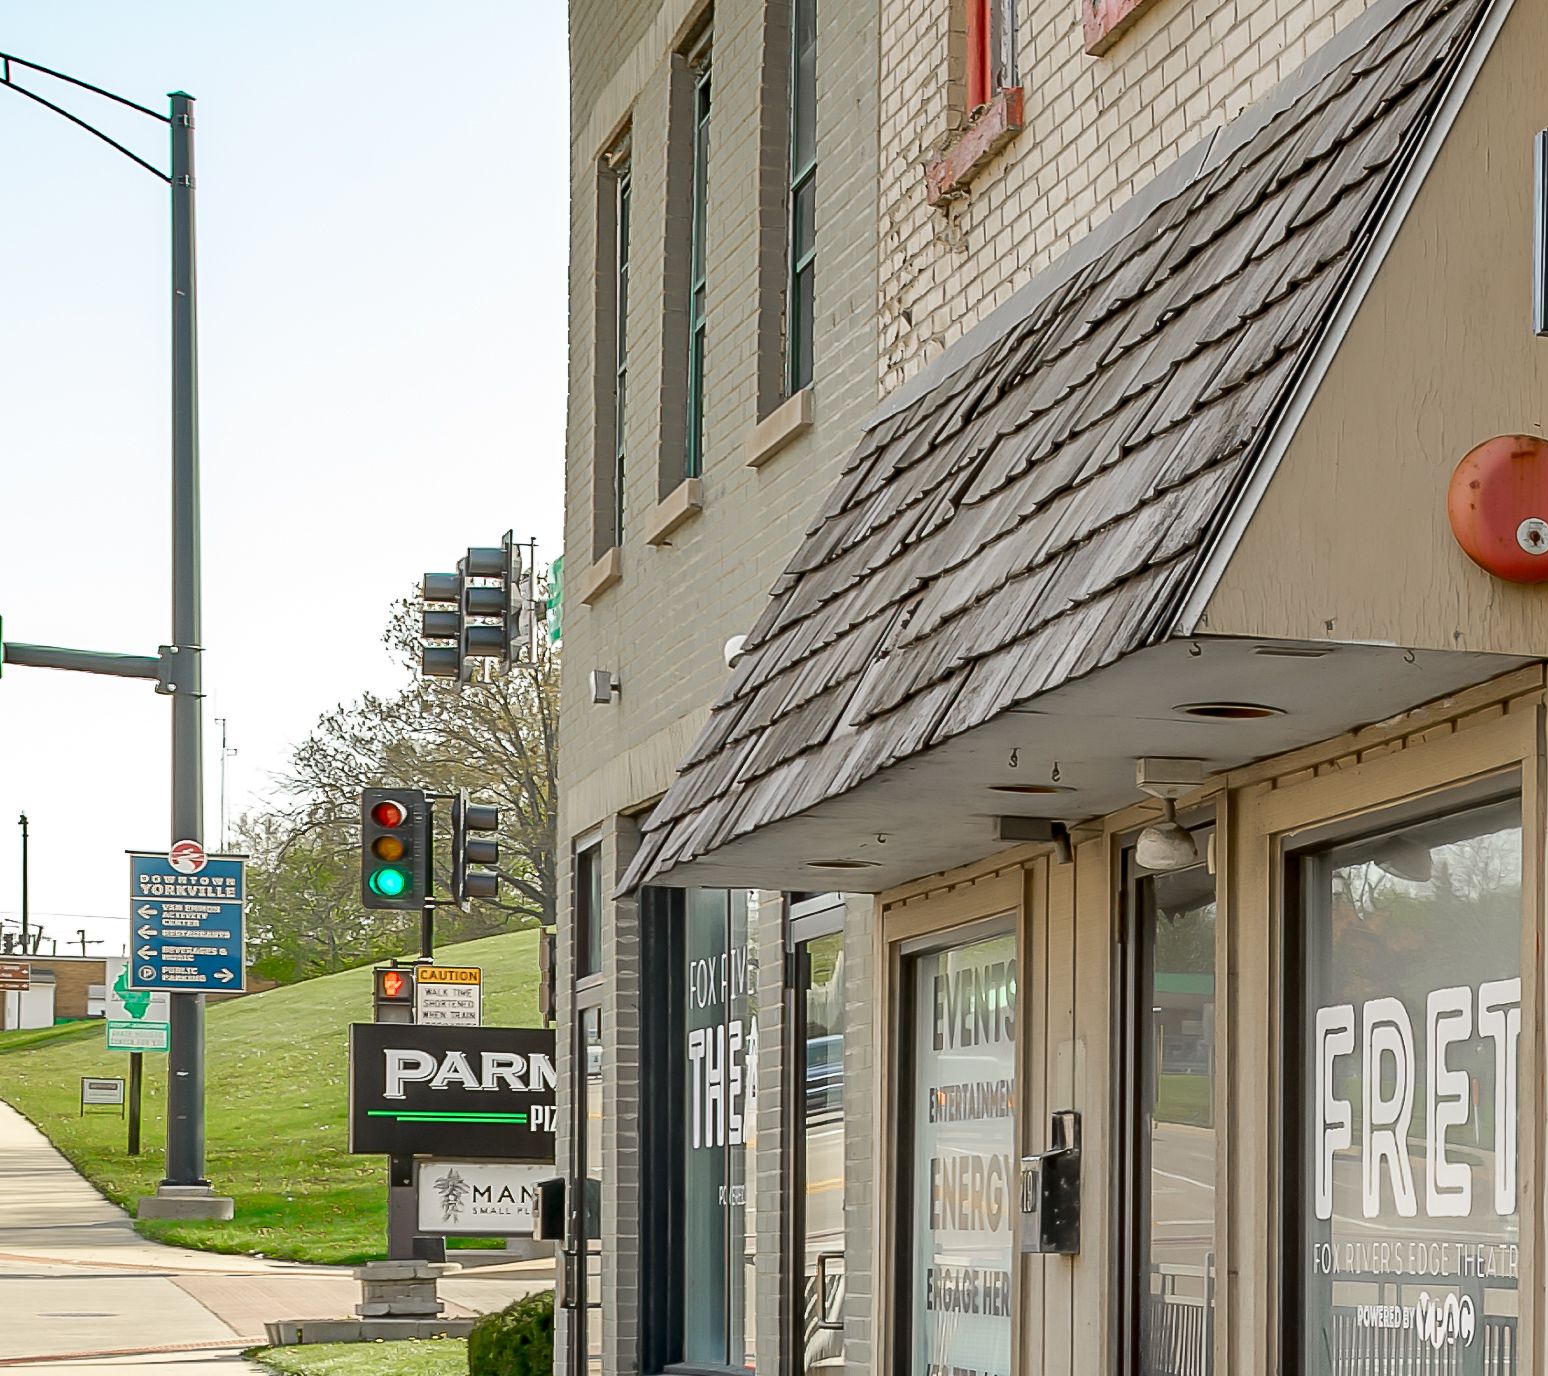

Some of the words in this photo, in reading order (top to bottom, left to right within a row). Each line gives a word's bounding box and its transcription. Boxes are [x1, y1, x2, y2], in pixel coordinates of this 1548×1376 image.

[140, 874, 236, 886] DOWNTOWN
[140, 884, 236, 897] YORKVILLE
[420, 969, 478, 982] CAUTION
[689, 956, 717, 1010] FOX
[425, 987, 448, 997] WALK
[453, 988, 472, 998] TIME
[423, 999, 474, 1009] SHORTENED
[933, 959, 1017, 1051] EVENTS
[423, 1010, 446, 1020] WHEN
[450, 1011, 475, 1020] TRAIN
[1315, 978, 1520, 1219] FRET
[472, 1207, 511, 1215] SMALL
[1314, 1243, 1339, 1274] FOX
[1346, 1242, 1402, 1275] RIVER'S
[1409, 1243, 1449, 1276] EDGE
[1456, 1243, 1518, 1279] THEATR
[927, 1267, 979, 1314] ENGAGE
[1357, 1304, 1401, 1328] POWERED
[1403, 1307, 1416, 1329] BY
